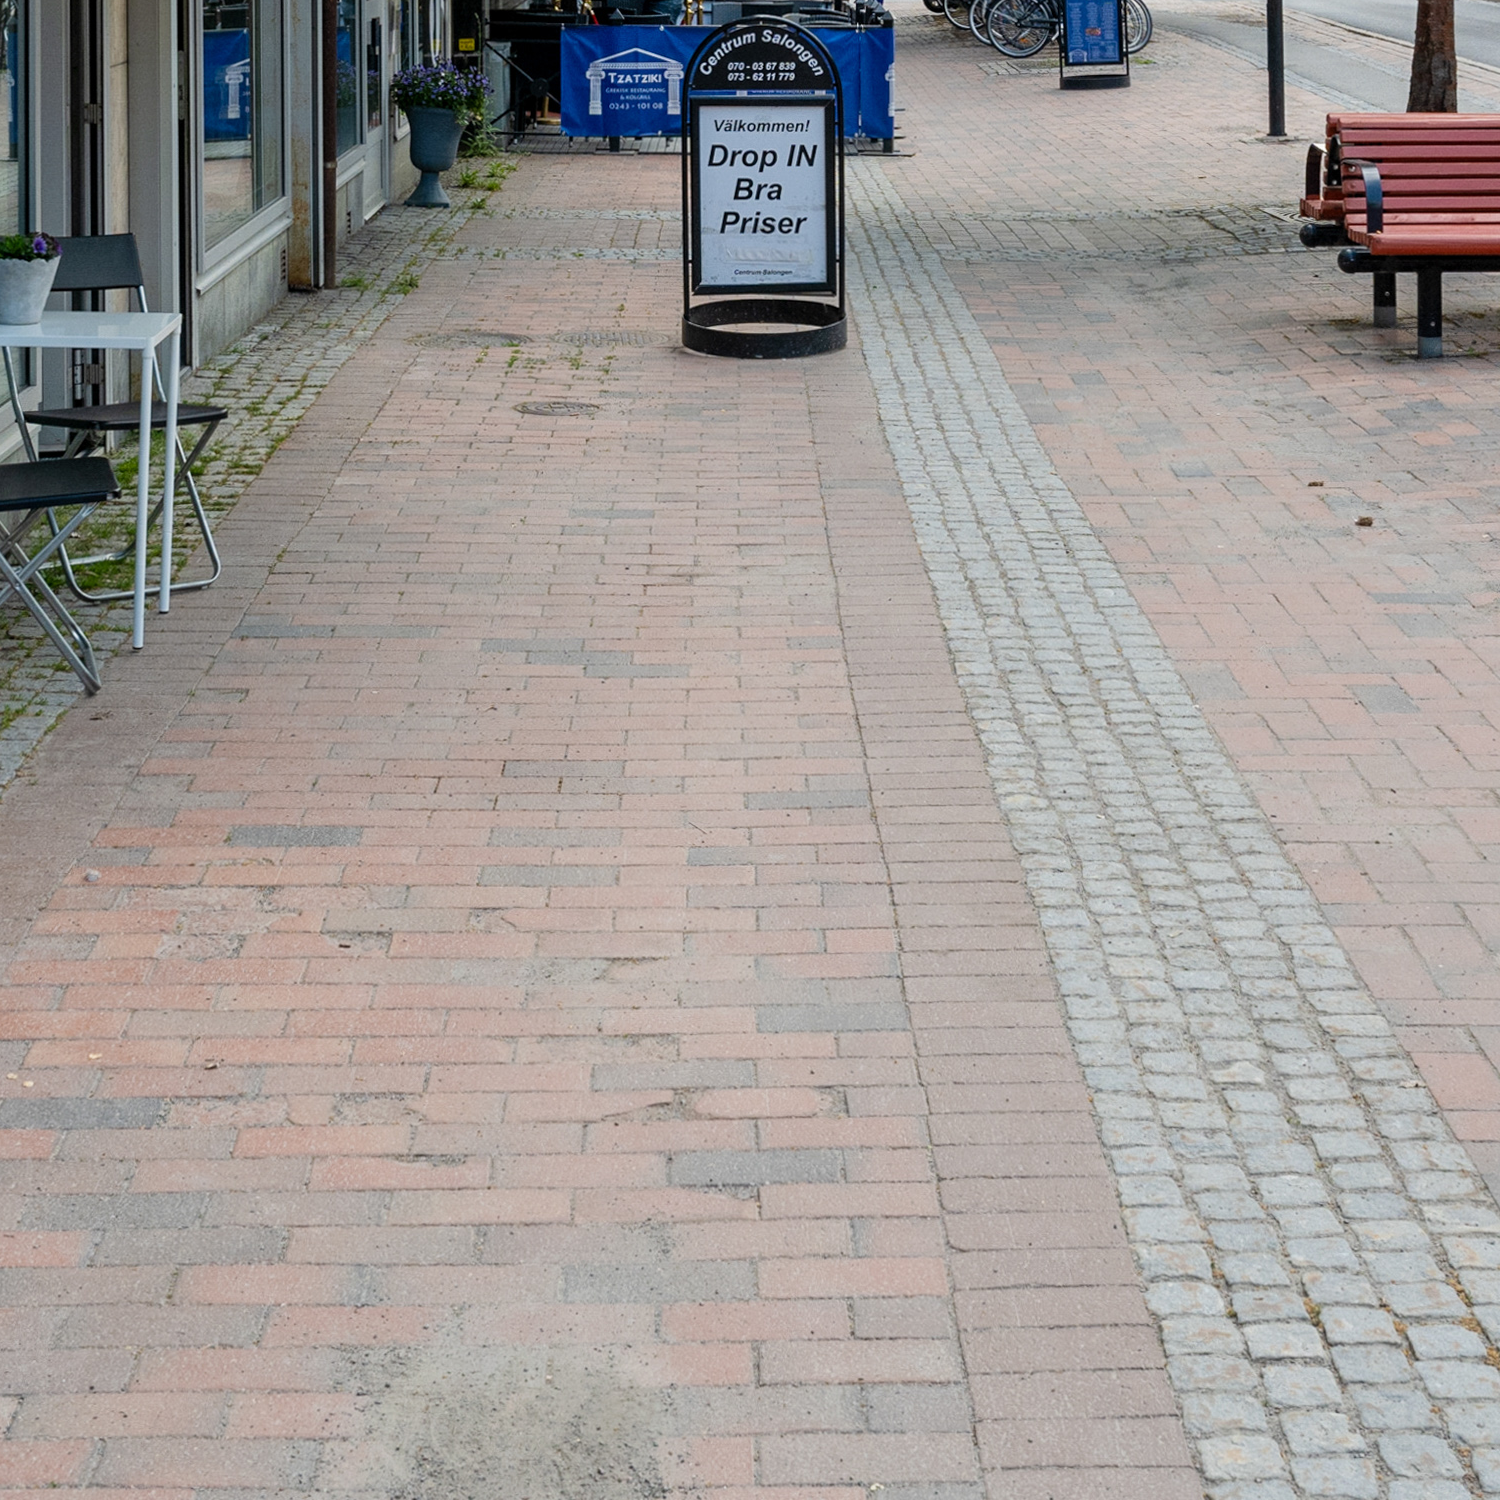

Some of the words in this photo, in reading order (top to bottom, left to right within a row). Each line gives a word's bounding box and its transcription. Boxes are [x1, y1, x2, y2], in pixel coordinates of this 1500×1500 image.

[699, 31, 757, 76] Centrum
[760, 29, 825, 77] Salongen
[727, 62, 745, 71] 070
[752, 62, 764, 71] 03
[765, 62, 777, 71] 67
[778, 62, 796, 71] 839
[608, 72, 662, 84] TZATZIKI
[727, 72, 745, 81] 073
[752, 72, 764, 81] 62
[766, 72, 776, 81] 11
[778, 72, 796, 81] 779
[608, 102, 630, 110] 0243
[713, 119, 811, 133] Välkommen!
[707, 144, 778, 173] Drop
[786, 144, 818, 167] IN
[733, 177, 783, 201] Bra
[719, 211, 808, 234] Priser
[762, 269, 793, 277] Salongen
